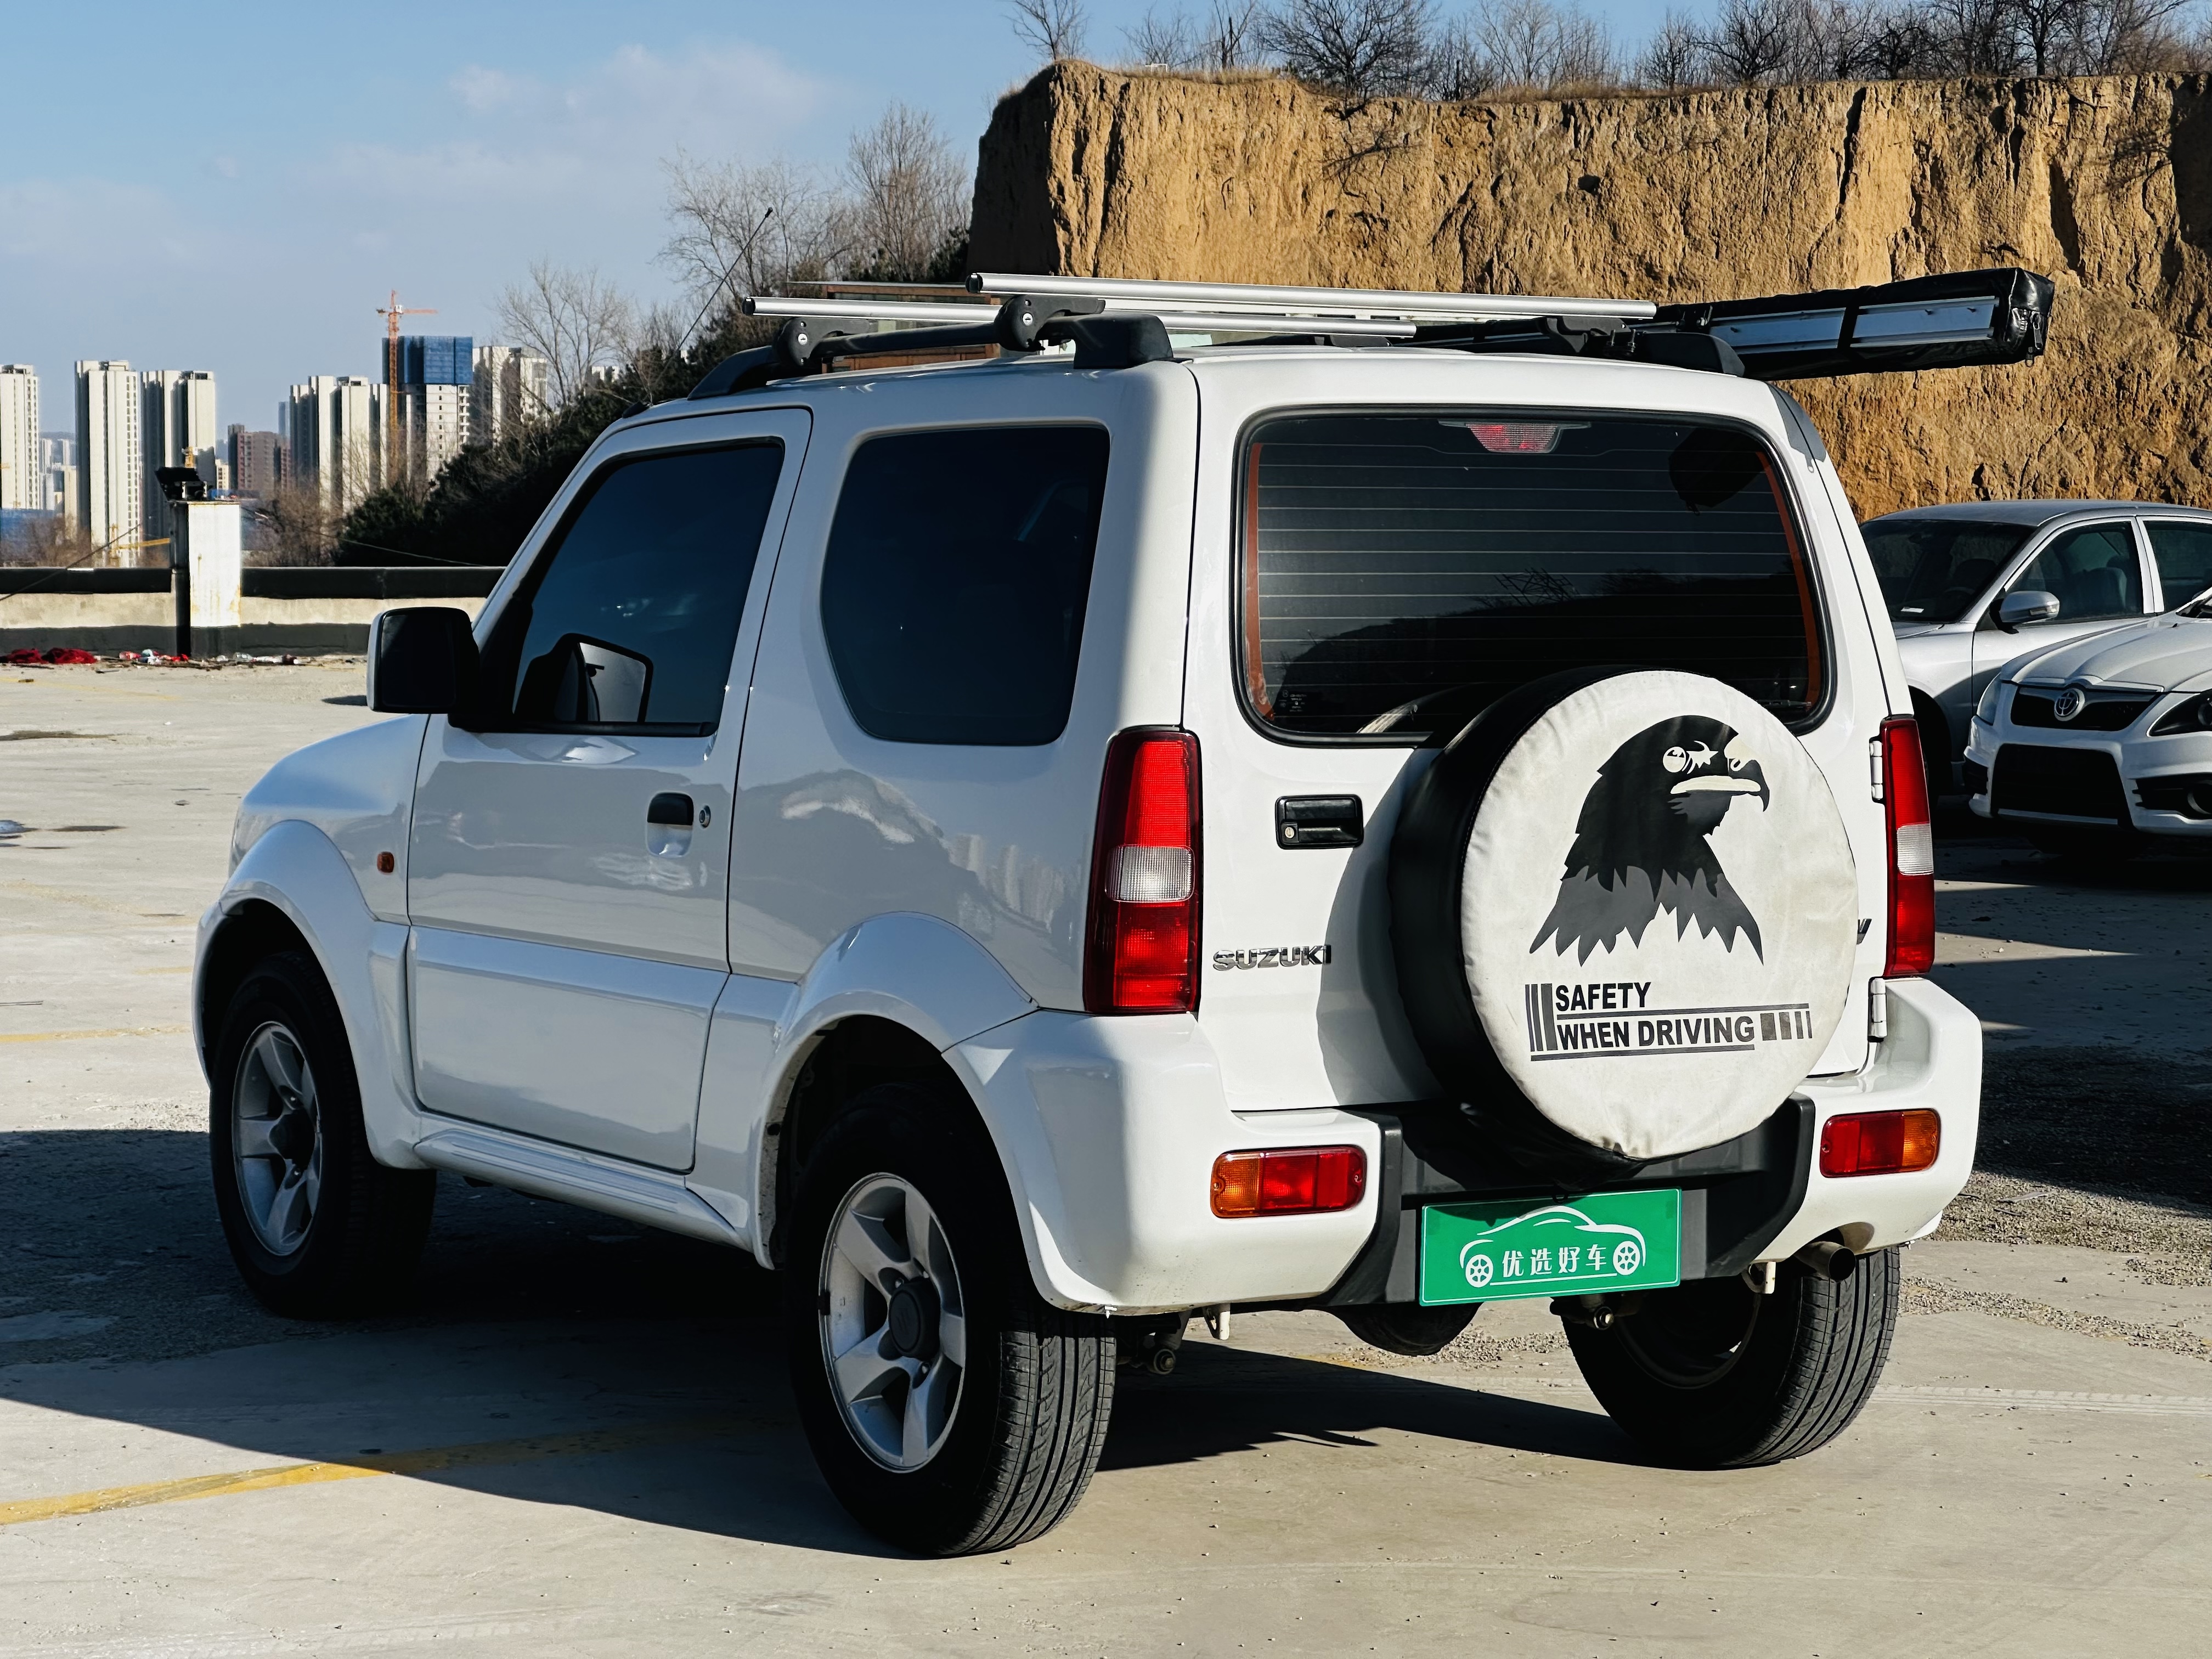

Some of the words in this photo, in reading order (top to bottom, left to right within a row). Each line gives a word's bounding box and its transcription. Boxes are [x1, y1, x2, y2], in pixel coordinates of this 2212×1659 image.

[1212, 944, 1332, 971] SUZUKI
[1555, 981, 1651, 1012] SAFETY
[1557, 1020, 1630, 1050] WHEN
[1638, 1016, 1754, 1047] DRIVING
[1502, 1244, 1607, 1278] 优选好车
